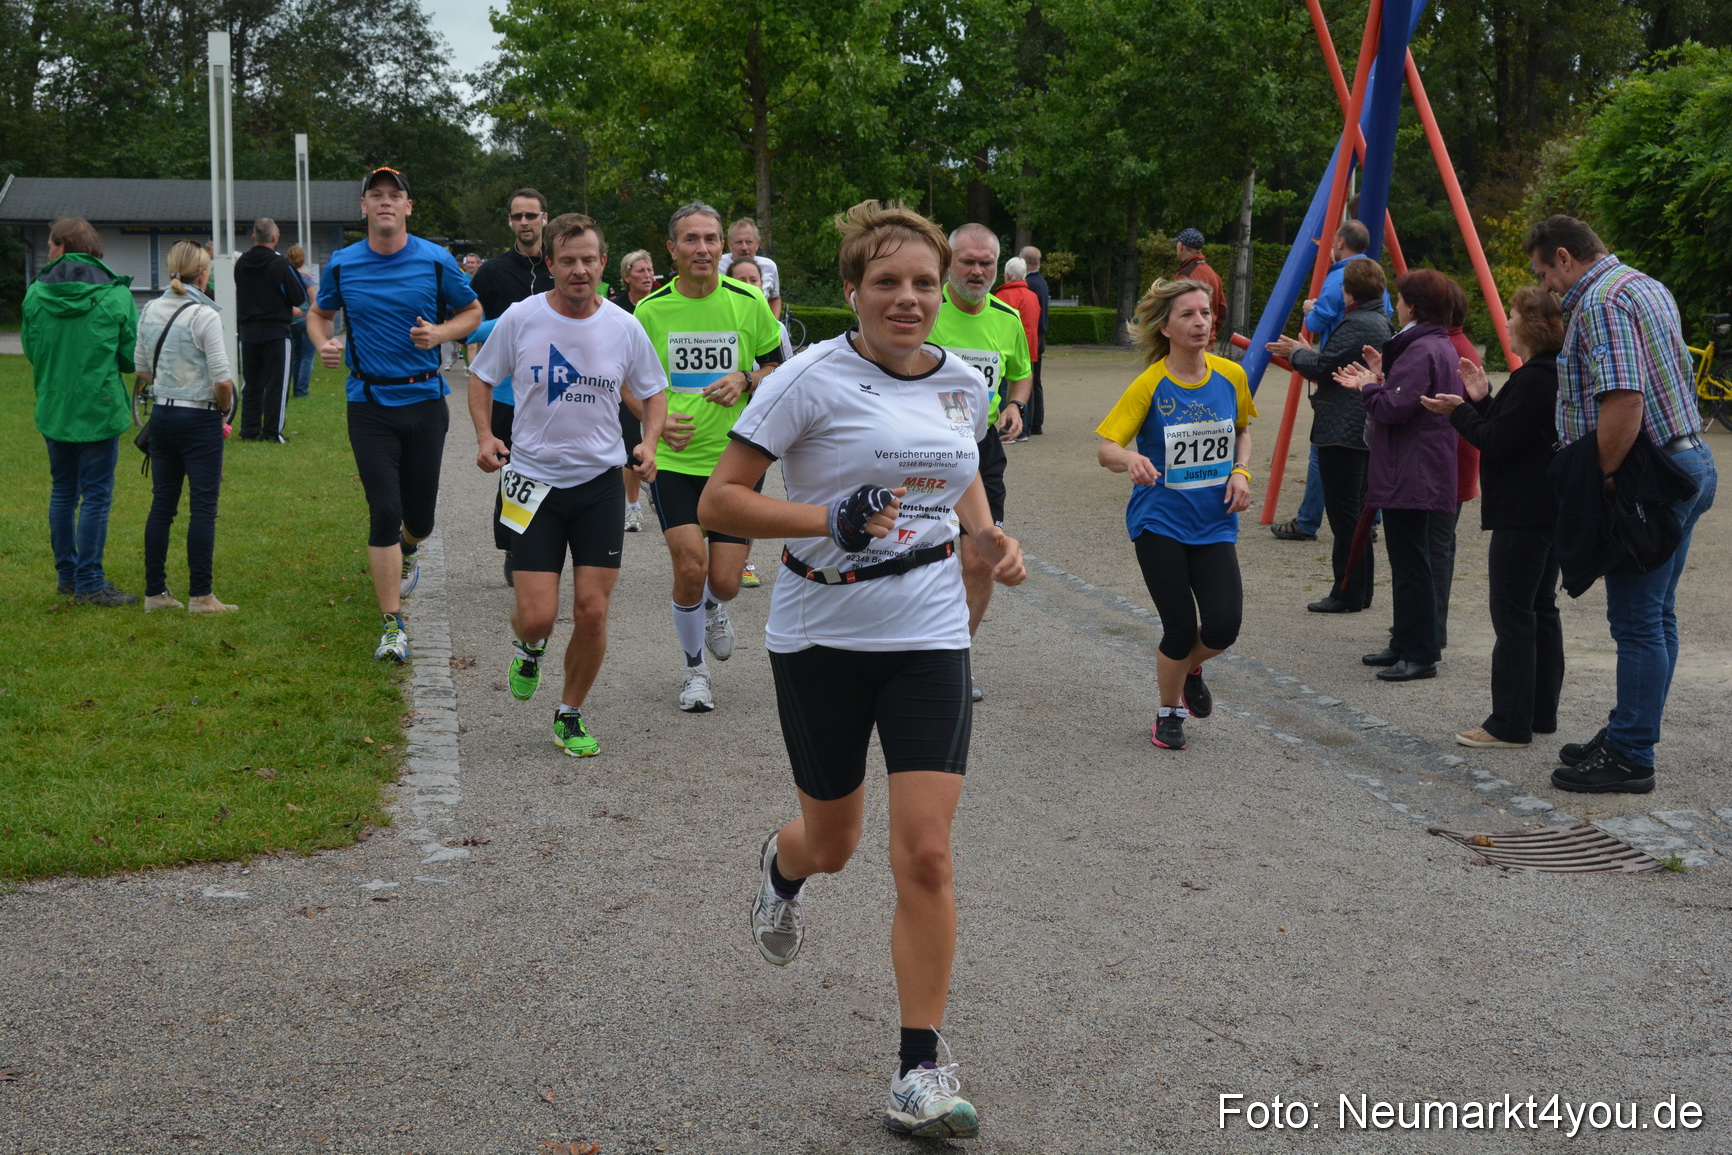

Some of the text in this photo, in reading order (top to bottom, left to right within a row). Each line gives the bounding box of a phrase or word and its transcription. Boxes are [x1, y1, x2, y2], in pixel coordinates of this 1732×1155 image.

[675, 347, 732, 370] 3350
[961, 354, 991, 362] Neumarkt
[558, 390, 596, 403] Team
[1166, 428, 1225, 439] PARTL Neumarkt
[874, 450, 953, 461] Versicherungen
[1174, 436, 1229, 465] 2128
[1184, 468, 1218, 480] Justyna
[904, 477, 948, 489] MERZ
[846, 555, 870, 563] 92348
